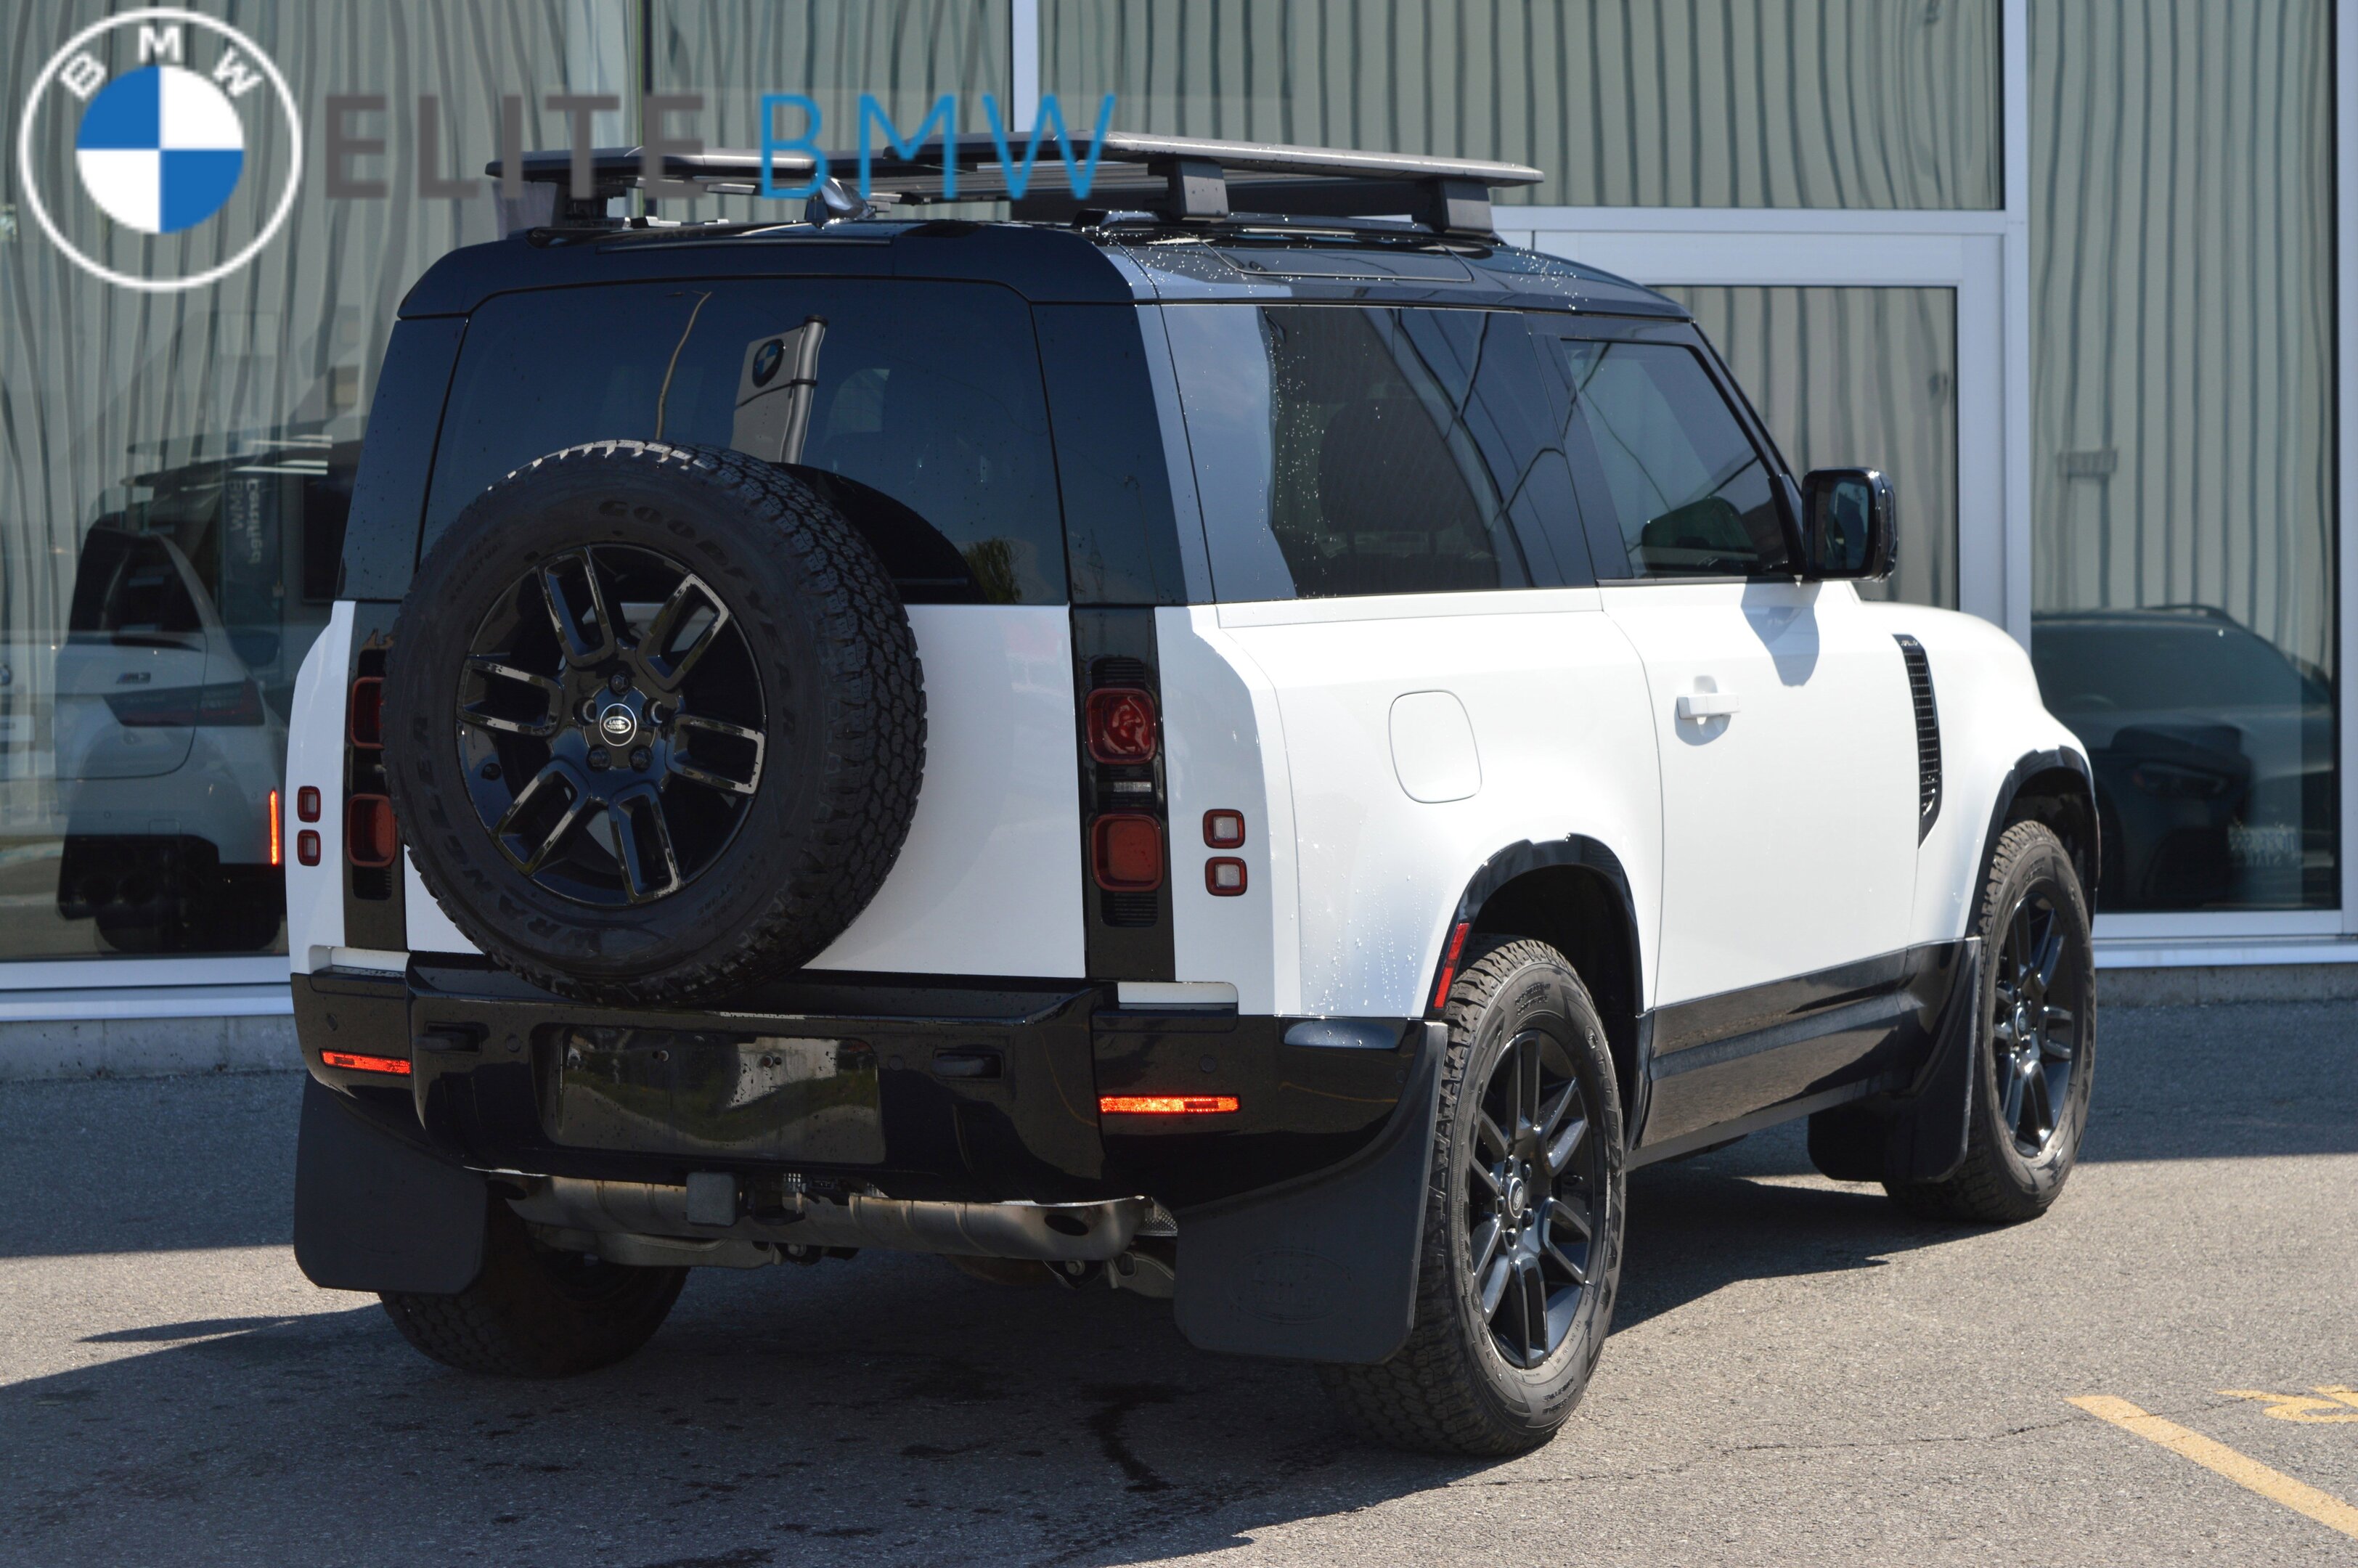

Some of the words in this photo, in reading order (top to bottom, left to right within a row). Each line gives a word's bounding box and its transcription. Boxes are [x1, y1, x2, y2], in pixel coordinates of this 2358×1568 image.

[598, 500, 796, 746] GOODYEAR
[412, 716, 603, 952] WRANGLER
[1584, 1025, 1625, 1314] GOODYEAR
